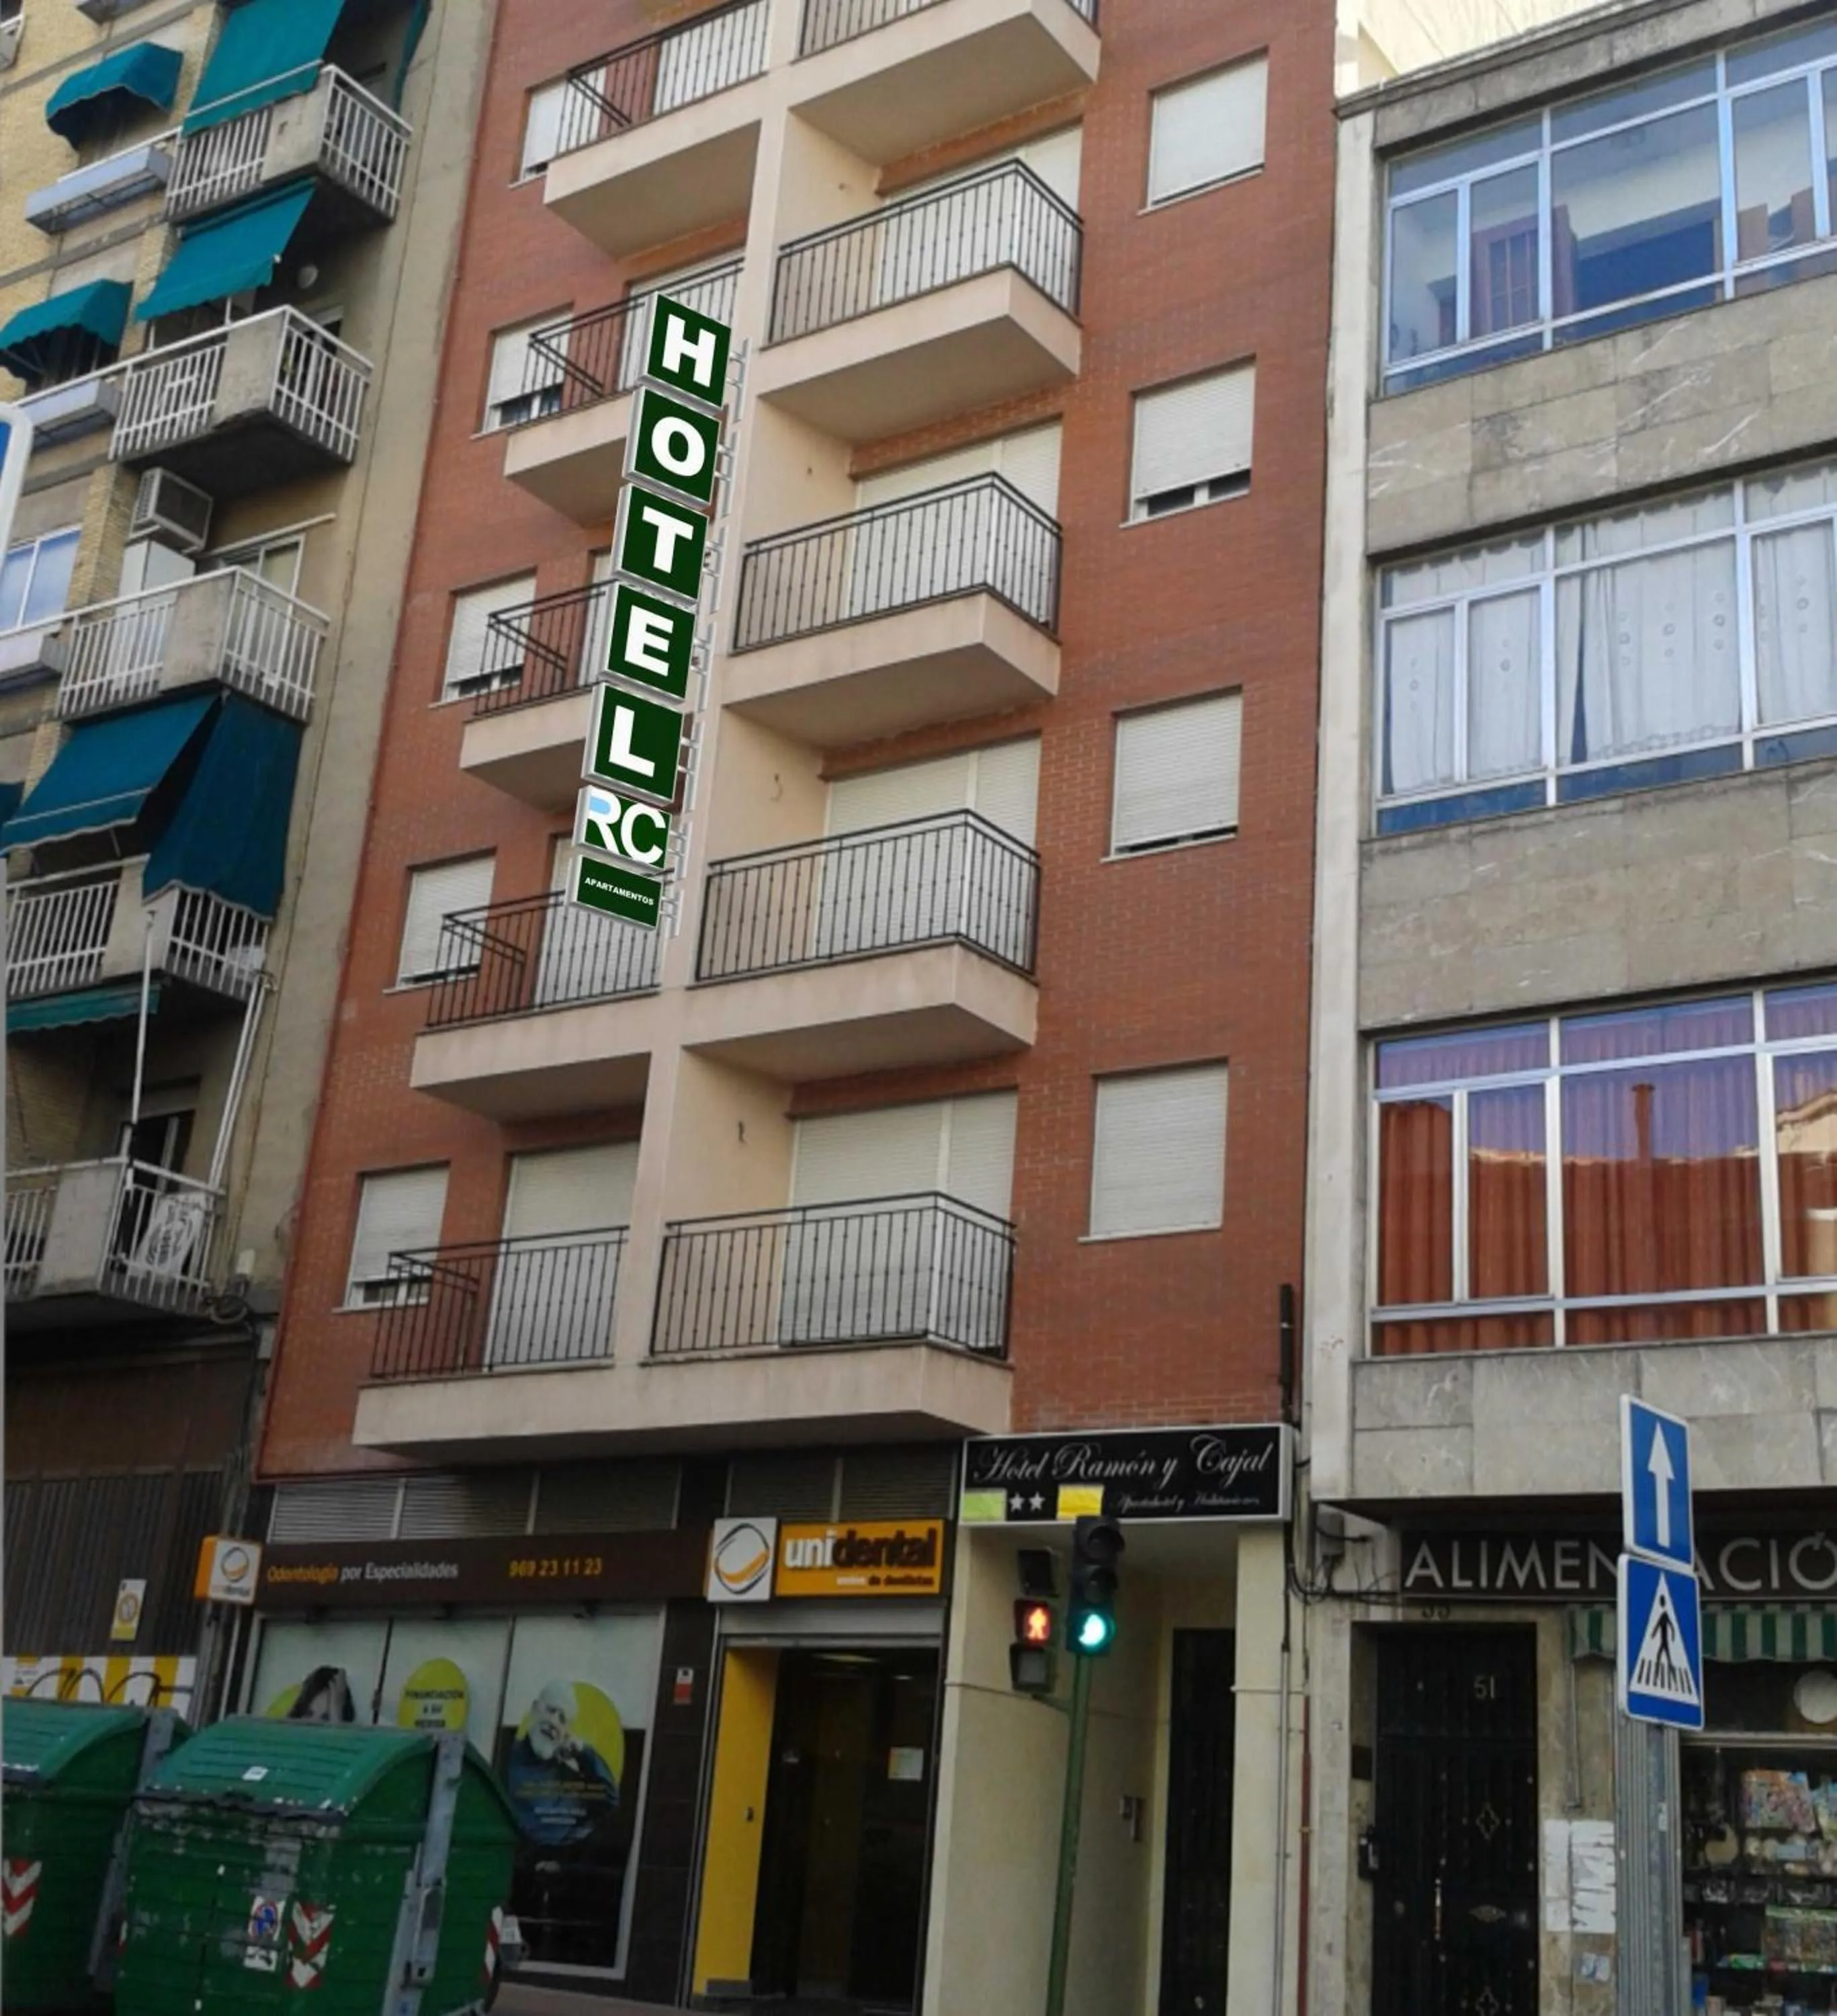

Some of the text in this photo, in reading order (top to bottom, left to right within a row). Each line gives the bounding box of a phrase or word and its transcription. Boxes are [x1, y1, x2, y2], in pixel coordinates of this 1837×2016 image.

[609, 314, 716, 778] HOTEL
[586, 786, 667, 864] RC
[584, 876, 654, 906] APARTAMENTOS
[974, 1434, 1274, 1490] Hotel Ramón y Cajal
[539, 1559, 558, 1577] 23
[564, 1558, 579, 1576] 11
[583, 1556, 602, 1575] 23
[785, 1527, 937, 1568] unidental
[1405, 1531, 1837, 1591] ALIMENCIÓ
[340, 1566, 361, 1584] por
[365, 1560, 459, 1583] Especialidades
[1473, 1673, 1495, 1700] 51
